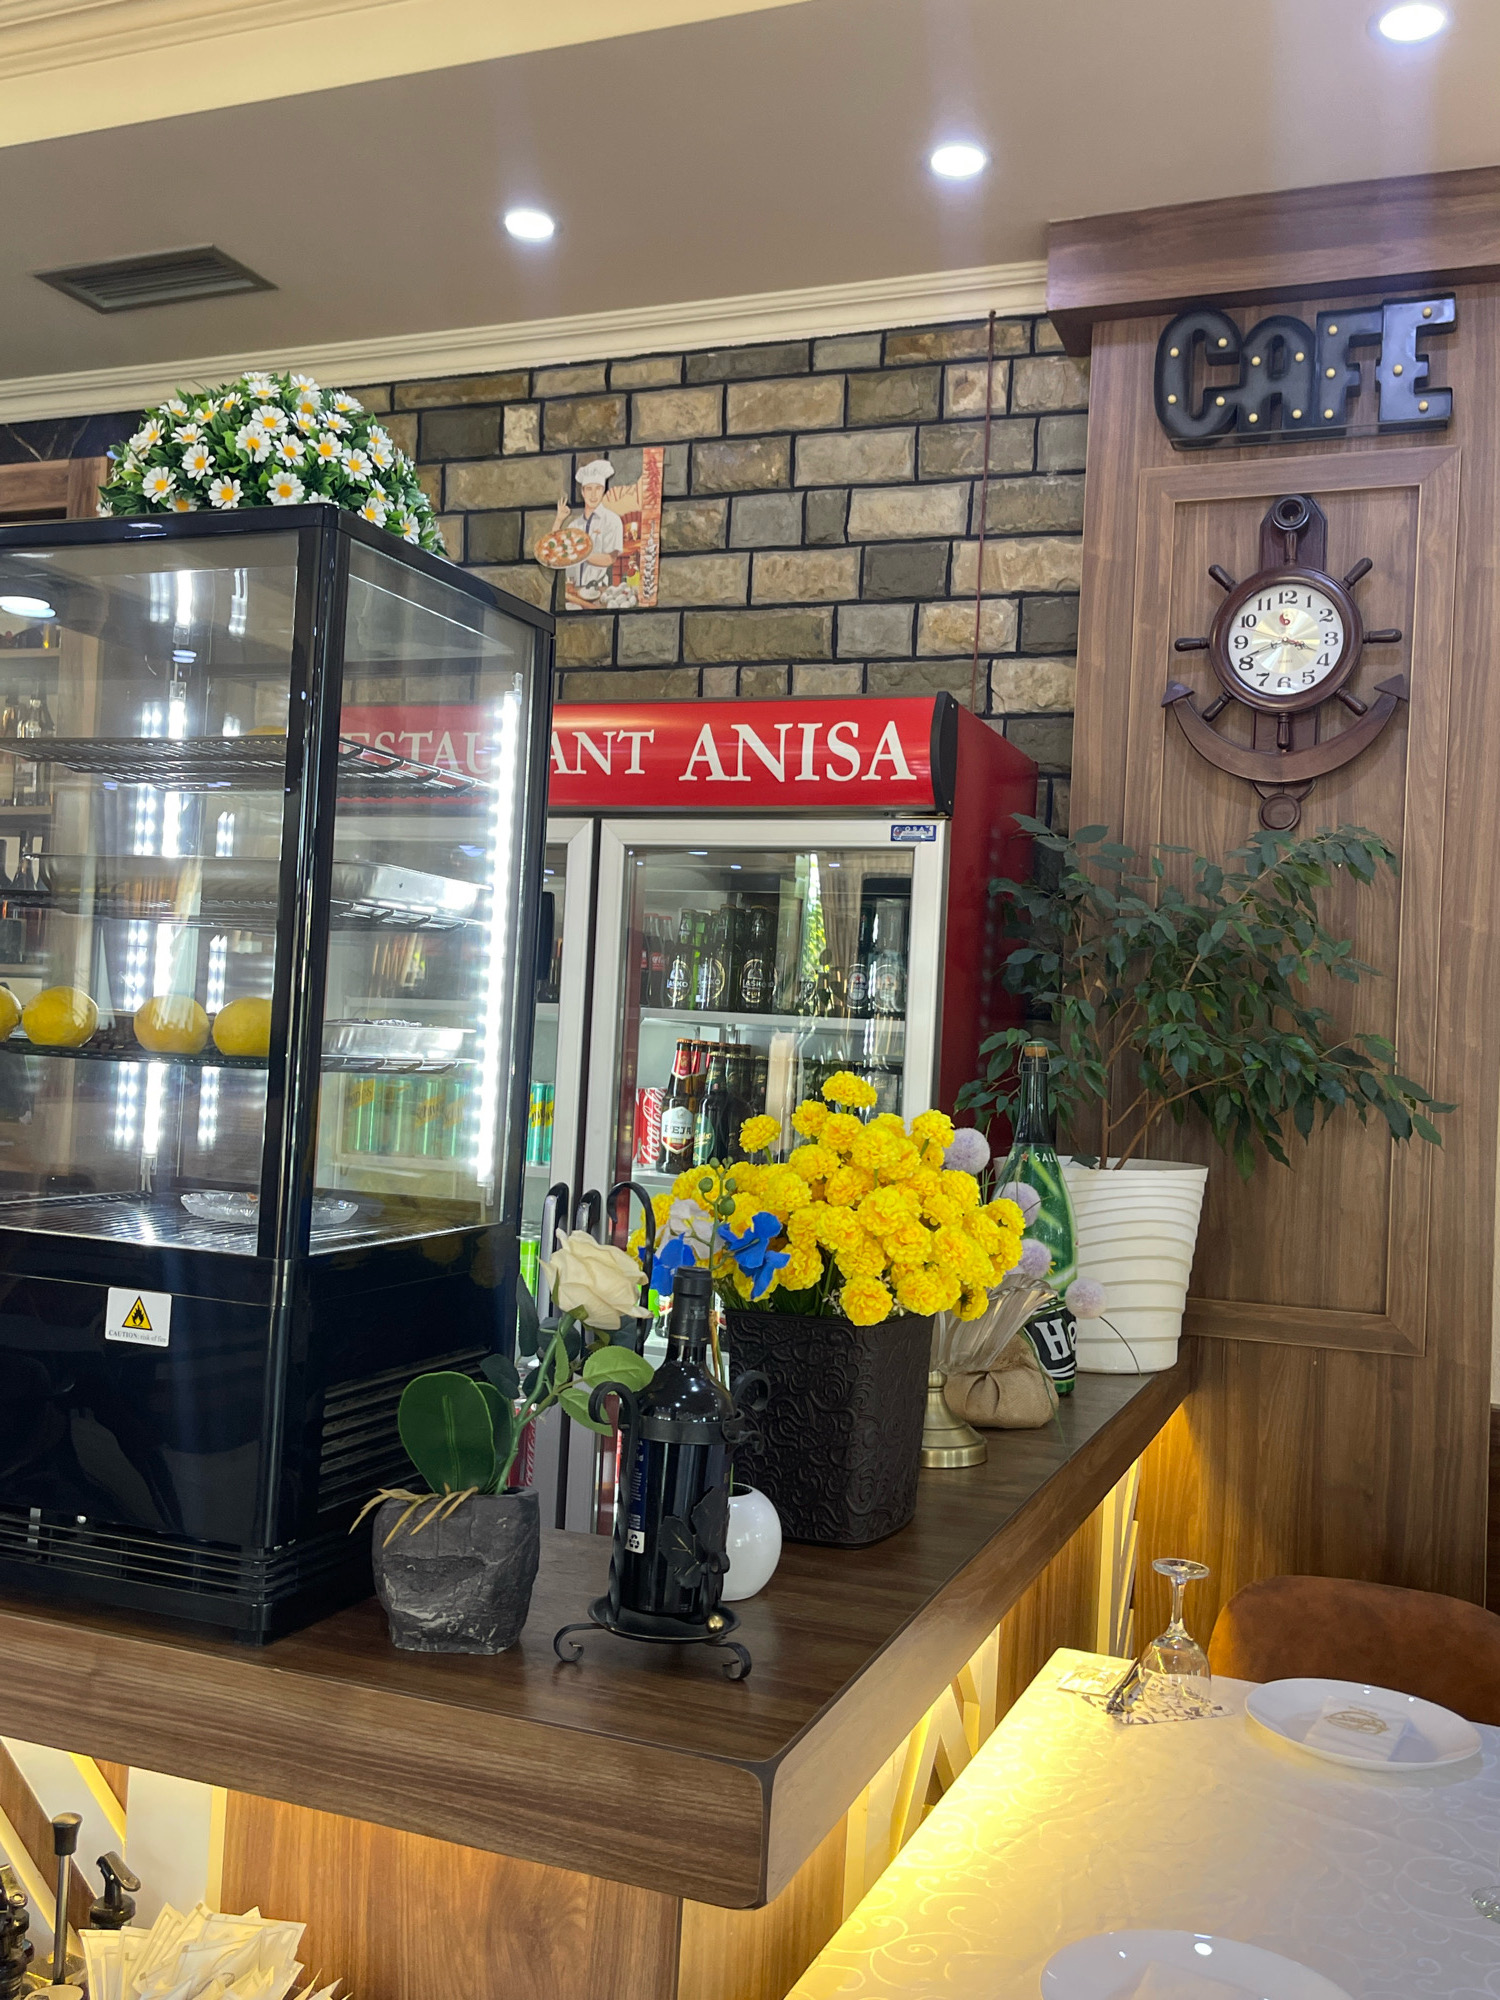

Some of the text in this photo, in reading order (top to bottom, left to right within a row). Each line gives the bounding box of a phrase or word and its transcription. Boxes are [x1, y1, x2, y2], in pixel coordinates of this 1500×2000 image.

[1154, 295, 1455, 447] CAFE
[1257, 597, 1272, 611] 11
[1278, 590, 1298, 604] 12
[1306, 595, 1312, 608] 1
[1241, 614, 1256, 628] 10
[1319, 608, 1334, 622] 2
[1234, 635, 1248, 649] 9
[1324, 631, 1338, 646] 3
[1238, 656, 1254, 671] 8
[1316, 652, 1331, 666] 4
[1256, 672, 1270, 687] 7
[1277, 676, 1292, 690] 6
[1302, 669, 1315, 685] 5
[678, 720, 918, 783] ANISA
